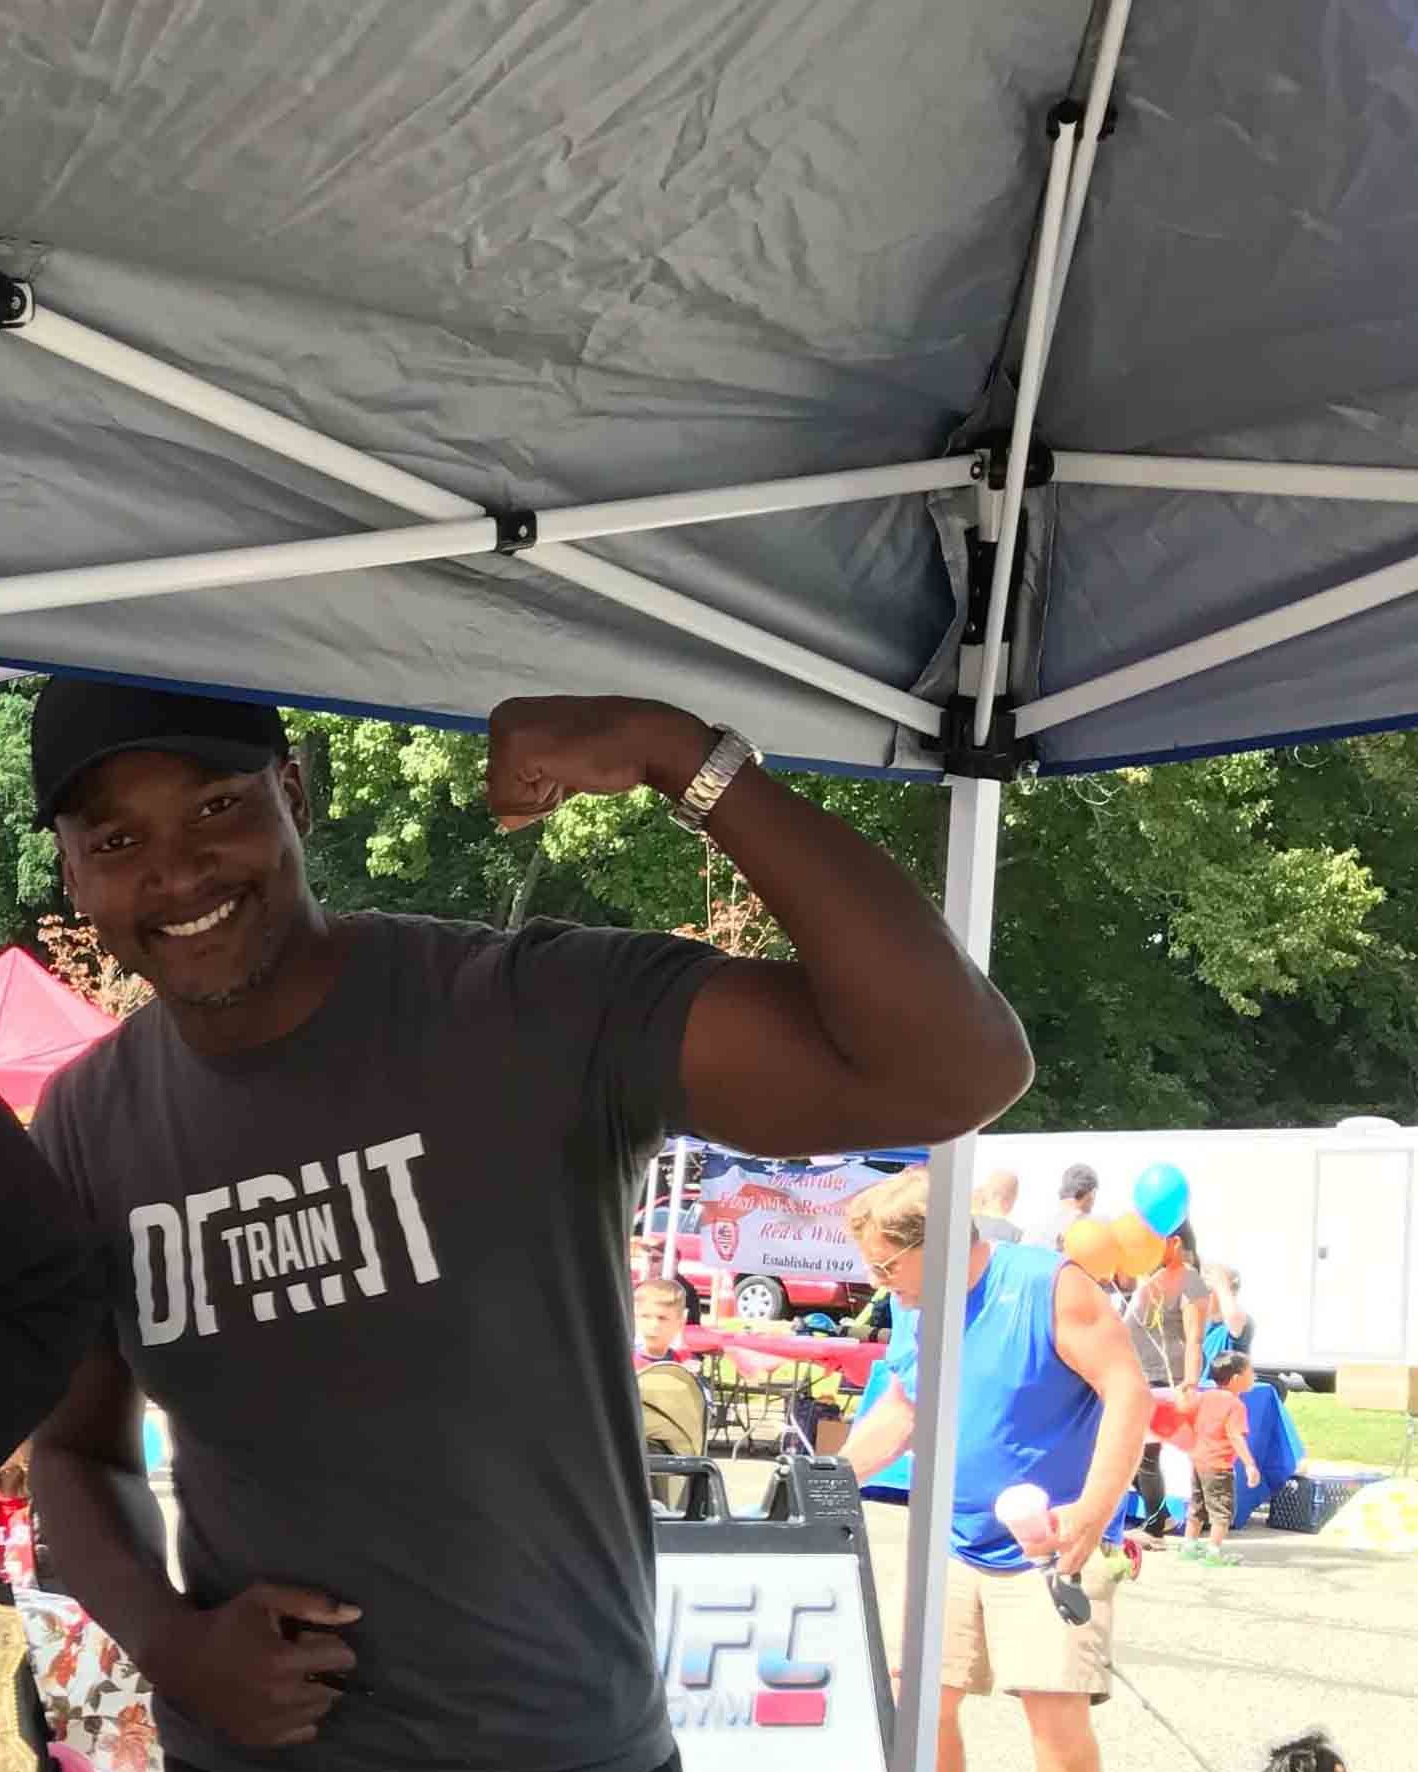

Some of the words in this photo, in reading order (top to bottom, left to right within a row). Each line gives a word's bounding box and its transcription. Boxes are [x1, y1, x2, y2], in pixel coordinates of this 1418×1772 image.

[221, 1203, 342, 1286] TRAIN
[762, 1253, 822, 1271] Established
[825, 1258, 854, 1273] 1949
